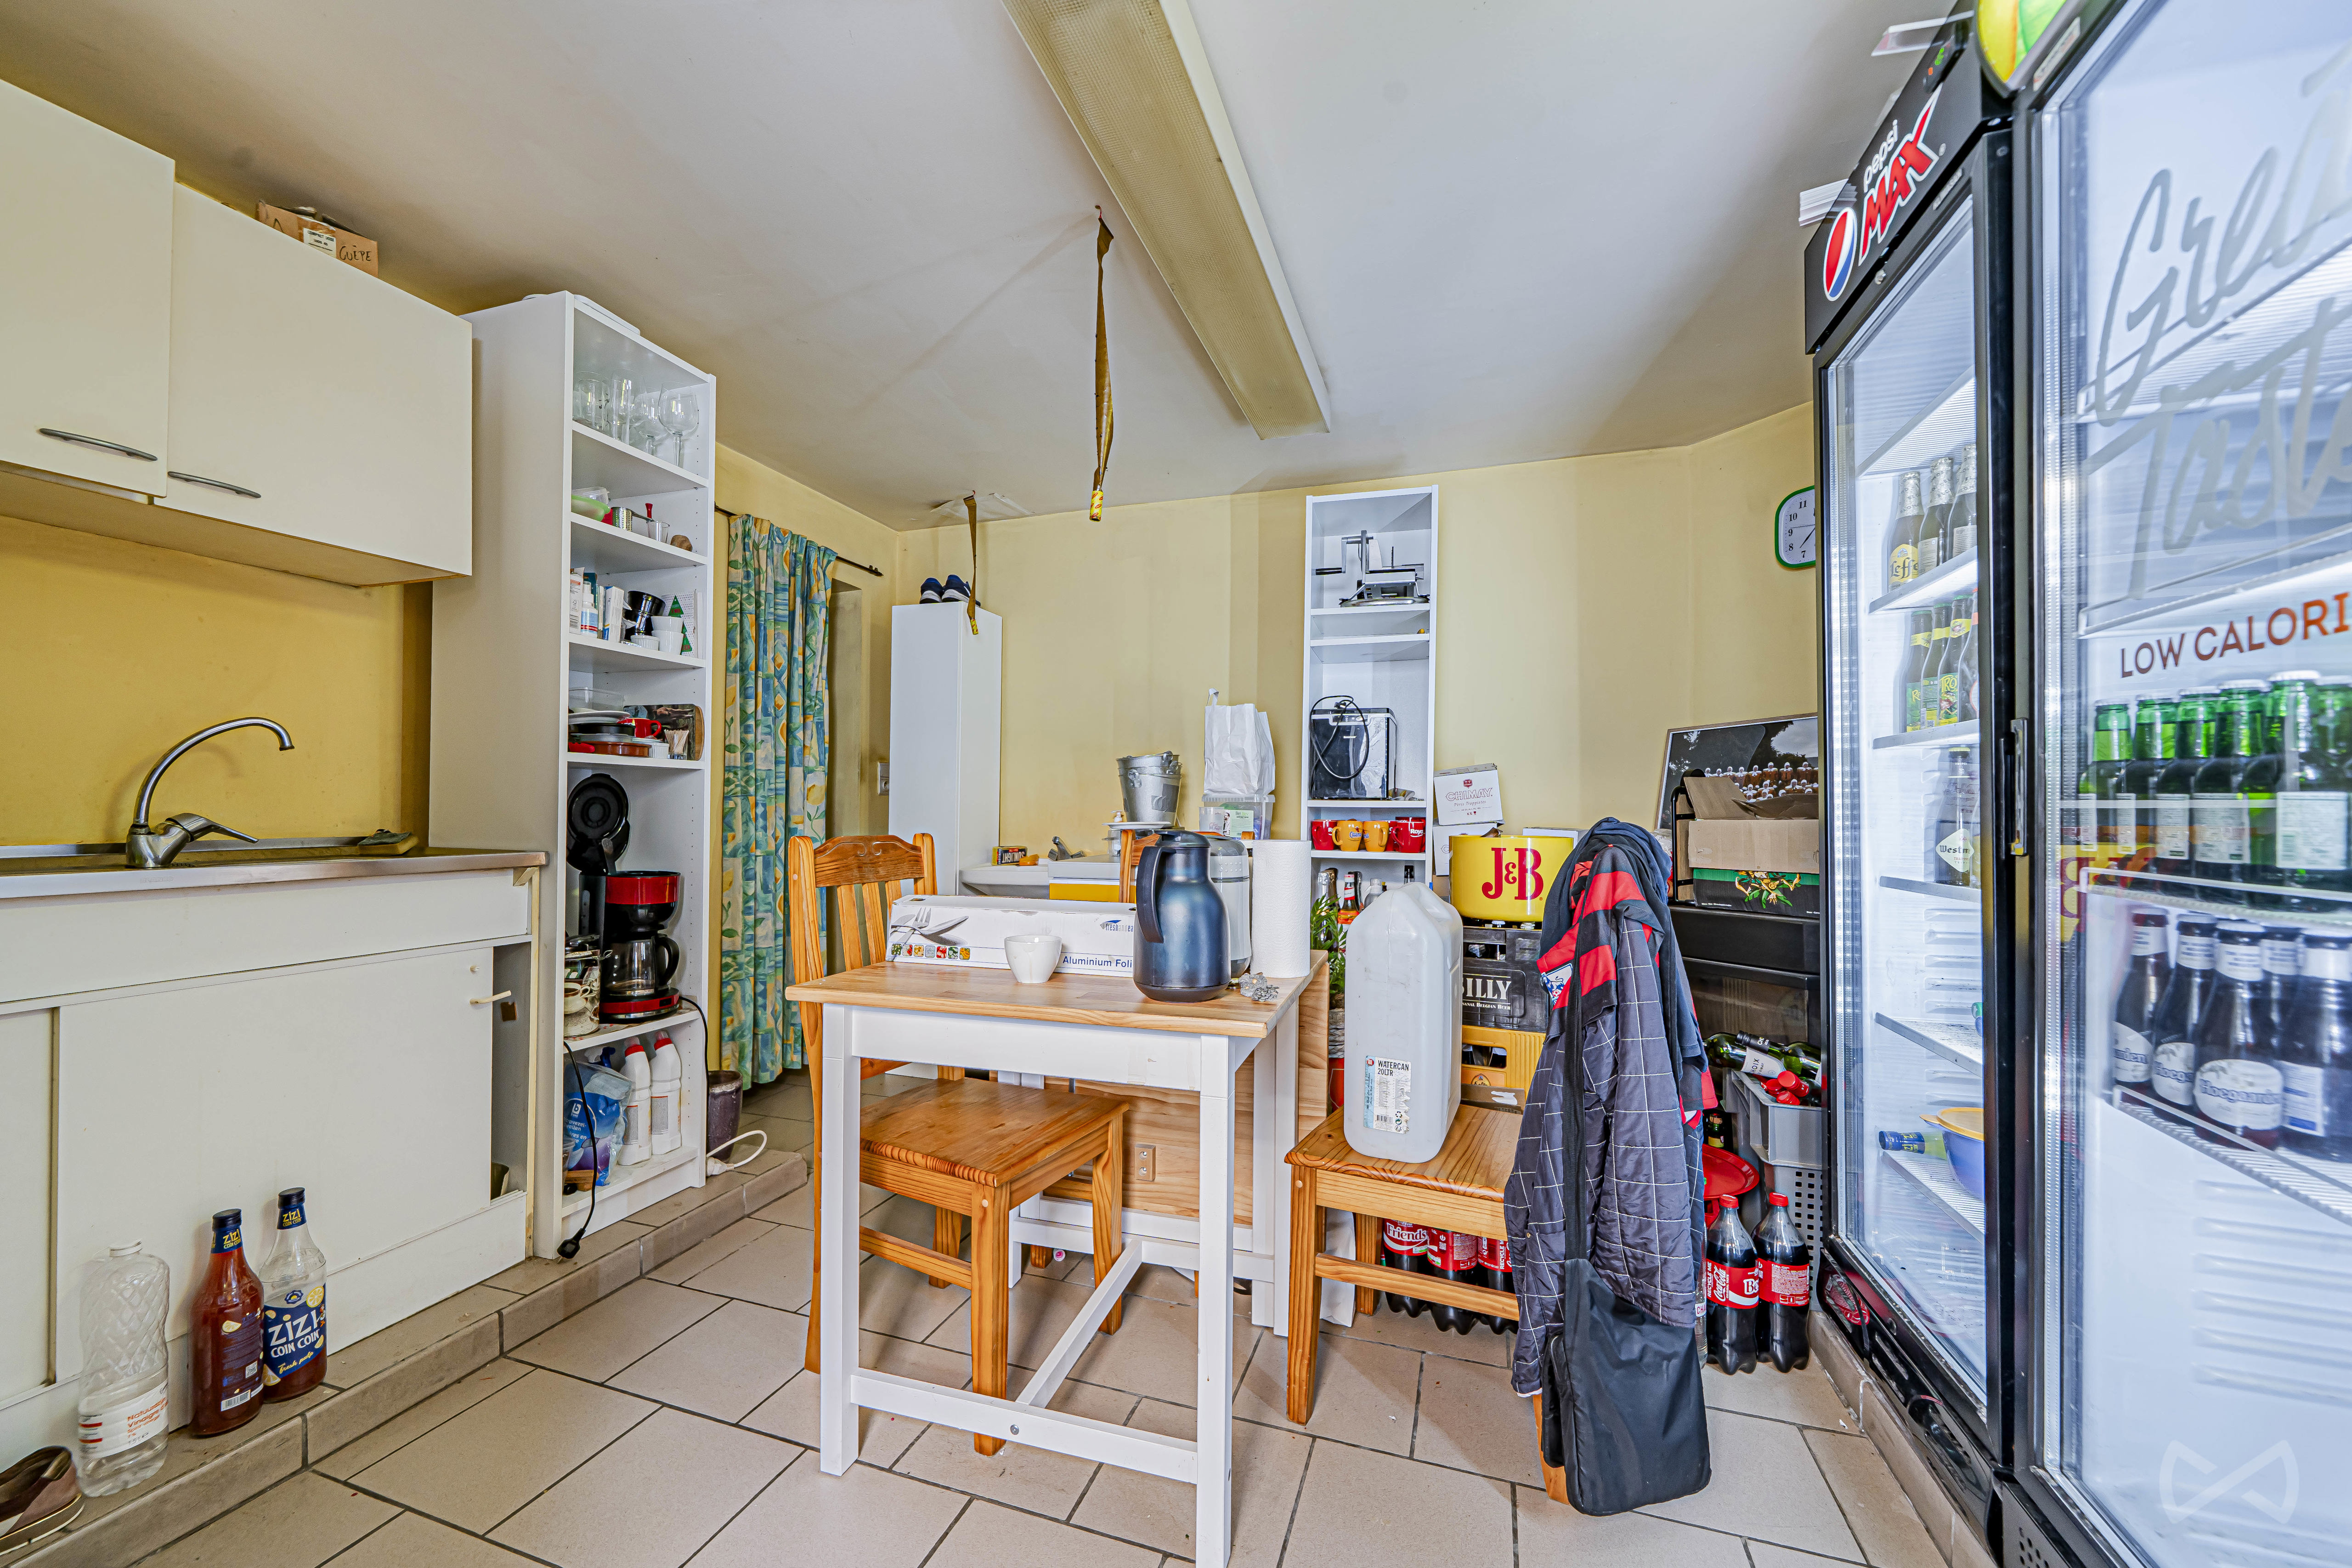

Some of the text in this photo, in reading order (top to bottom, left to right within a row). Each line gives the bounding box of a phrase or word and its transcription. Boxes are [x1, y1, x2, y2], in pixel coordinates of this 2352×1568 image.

[1864, 119, 1898, 192] pepsi
[1859, 83, 1943, 267] MAX
[2096, 51, 2352, 427] Grea
[1798, 500, 1807, 509] 11
[1789, 513, 1797, 521] 10
[1890, 557, 1918, 580] Leffe
[2121, 592, 2350, 678] LOW CALORI
[1446, 787, 1493, 801] CHIMAY
[1002, 851, 1025, 863] SUNLIGHT
[1481, 847, 1544, 900] J&B
[1063, 956, 1132, 968] Aluminium Foli
[1462, 978, 1511, 1000] ILLY
[1378, 1060, 1409, 1071] WATERCAN
[1750, 1058, 1760, 1073] HOIX
[1386, 1222, 1427, 1241] Friends
[1707, 1261, 1712, 1271] ME
[271, 1329, 319, 1358] COIN COIN
[299, 1351, 314, 1364] pulp
